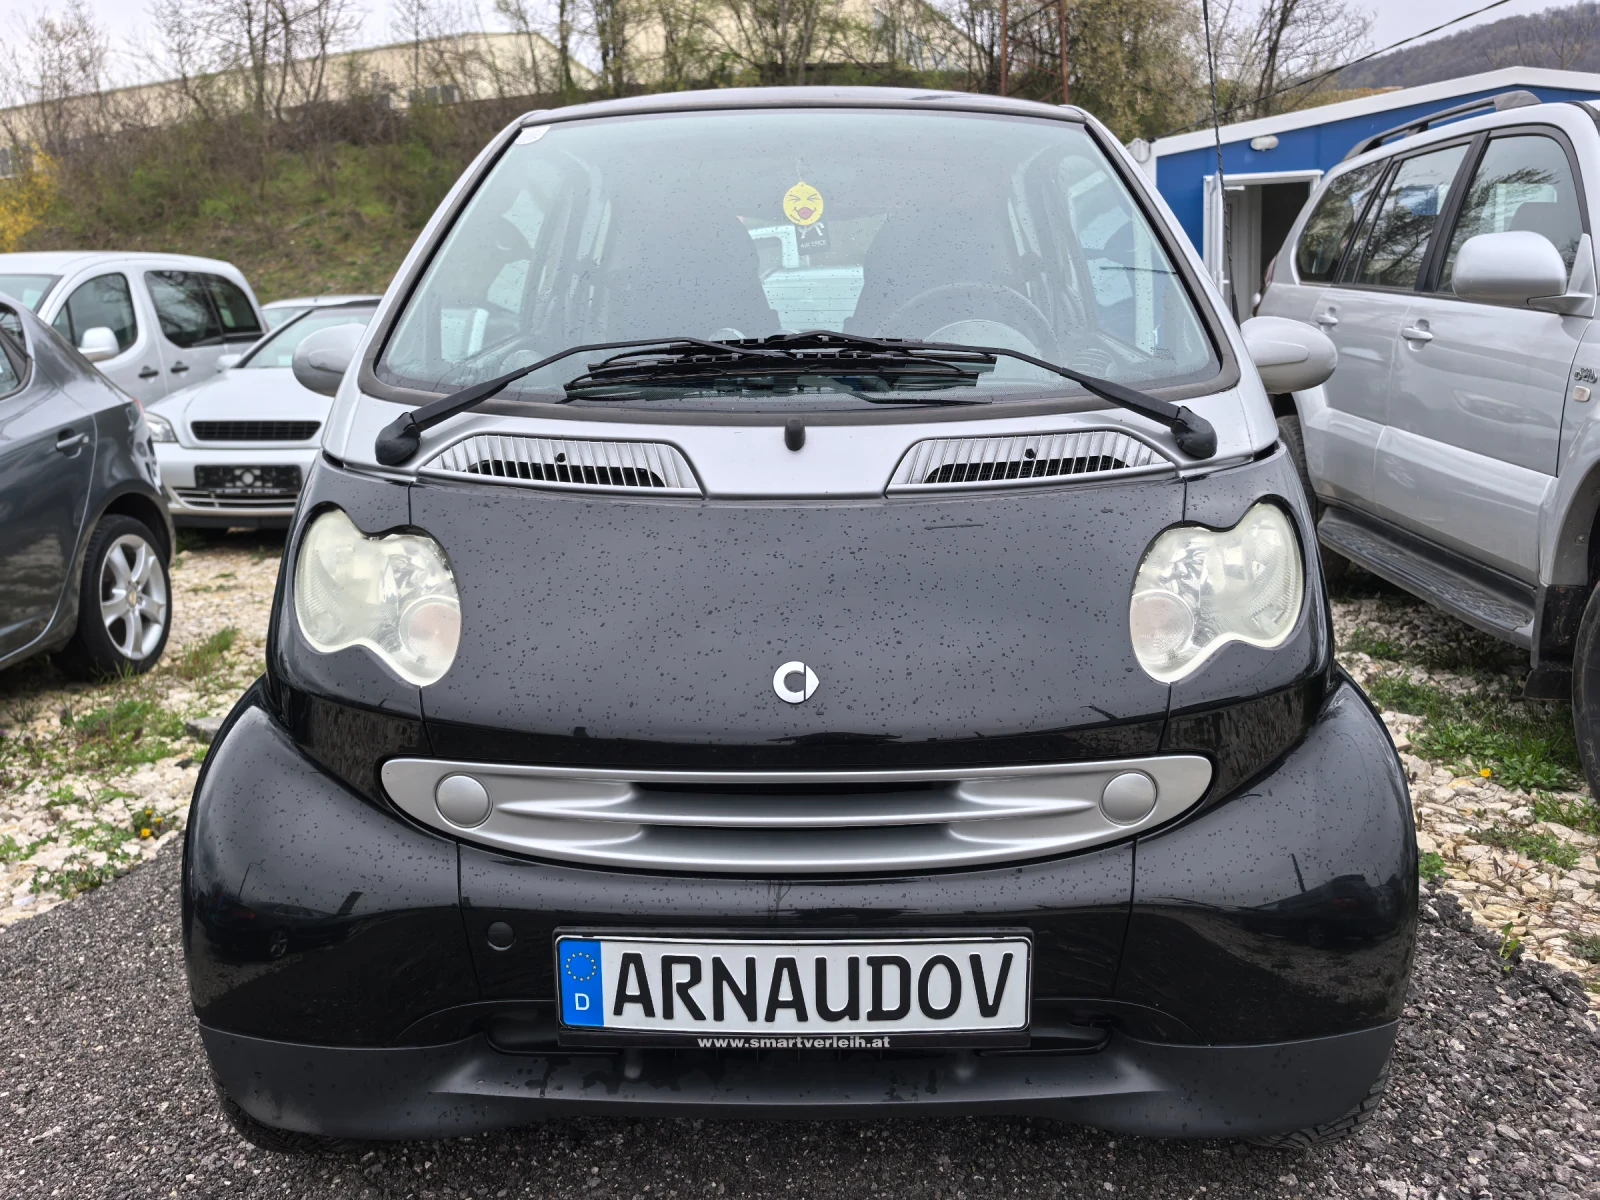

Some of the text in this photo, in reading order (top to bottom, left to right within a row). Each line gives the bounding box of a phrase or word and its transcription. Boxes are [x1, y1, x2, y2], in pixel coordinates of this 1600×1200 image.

[613, 952, 1014, 1022] ARNAUDOV
[574, 992, 590, 1011] D
[697, 1035, 891, 1049] www.smartverleih.at
